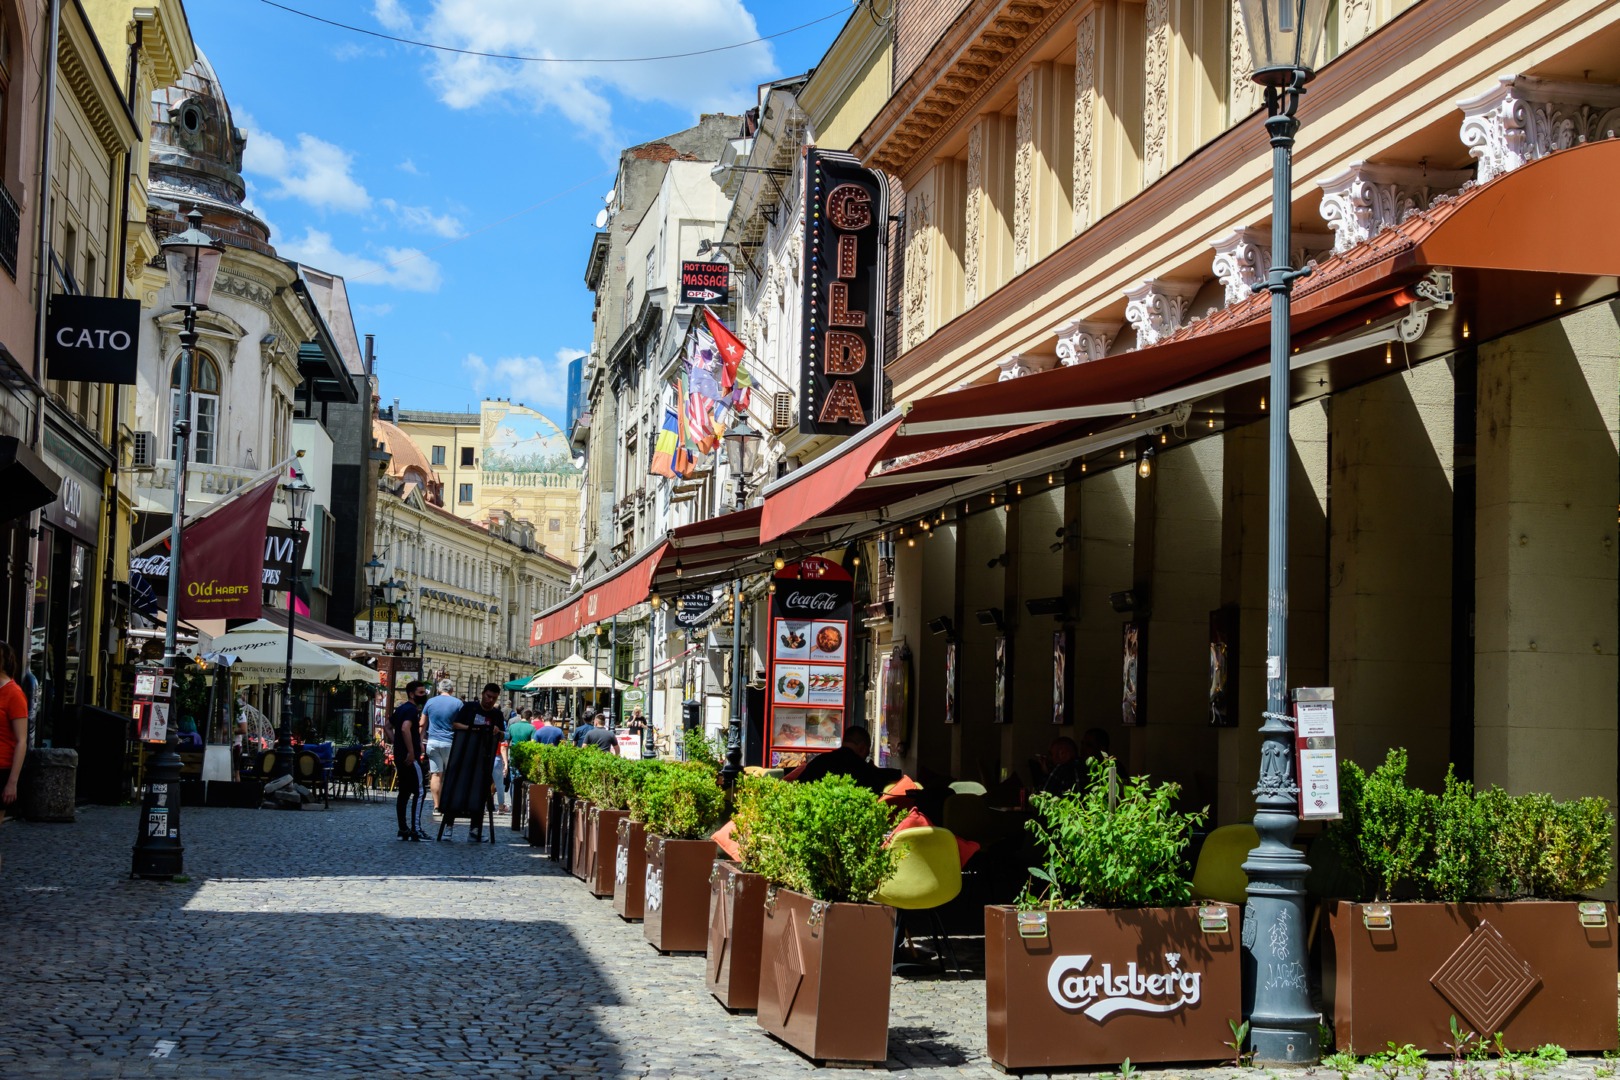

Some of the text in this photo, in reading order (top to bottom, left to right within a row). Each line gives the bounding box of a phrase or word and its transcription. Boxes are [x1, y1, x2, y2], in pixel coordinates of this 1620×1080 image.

[682, 273, 728, 287] MASSAGE
[683, 263, 728, 273] HOT TOUCH
[818, 182, 872, 426] GILDA
[56, 327, 131, 351] CATO
[63, 475, 82, 518] CATO
[187, 579, 249, 597] Old HABITS
[1047, 954, 1202, 1010] Carlsberg
